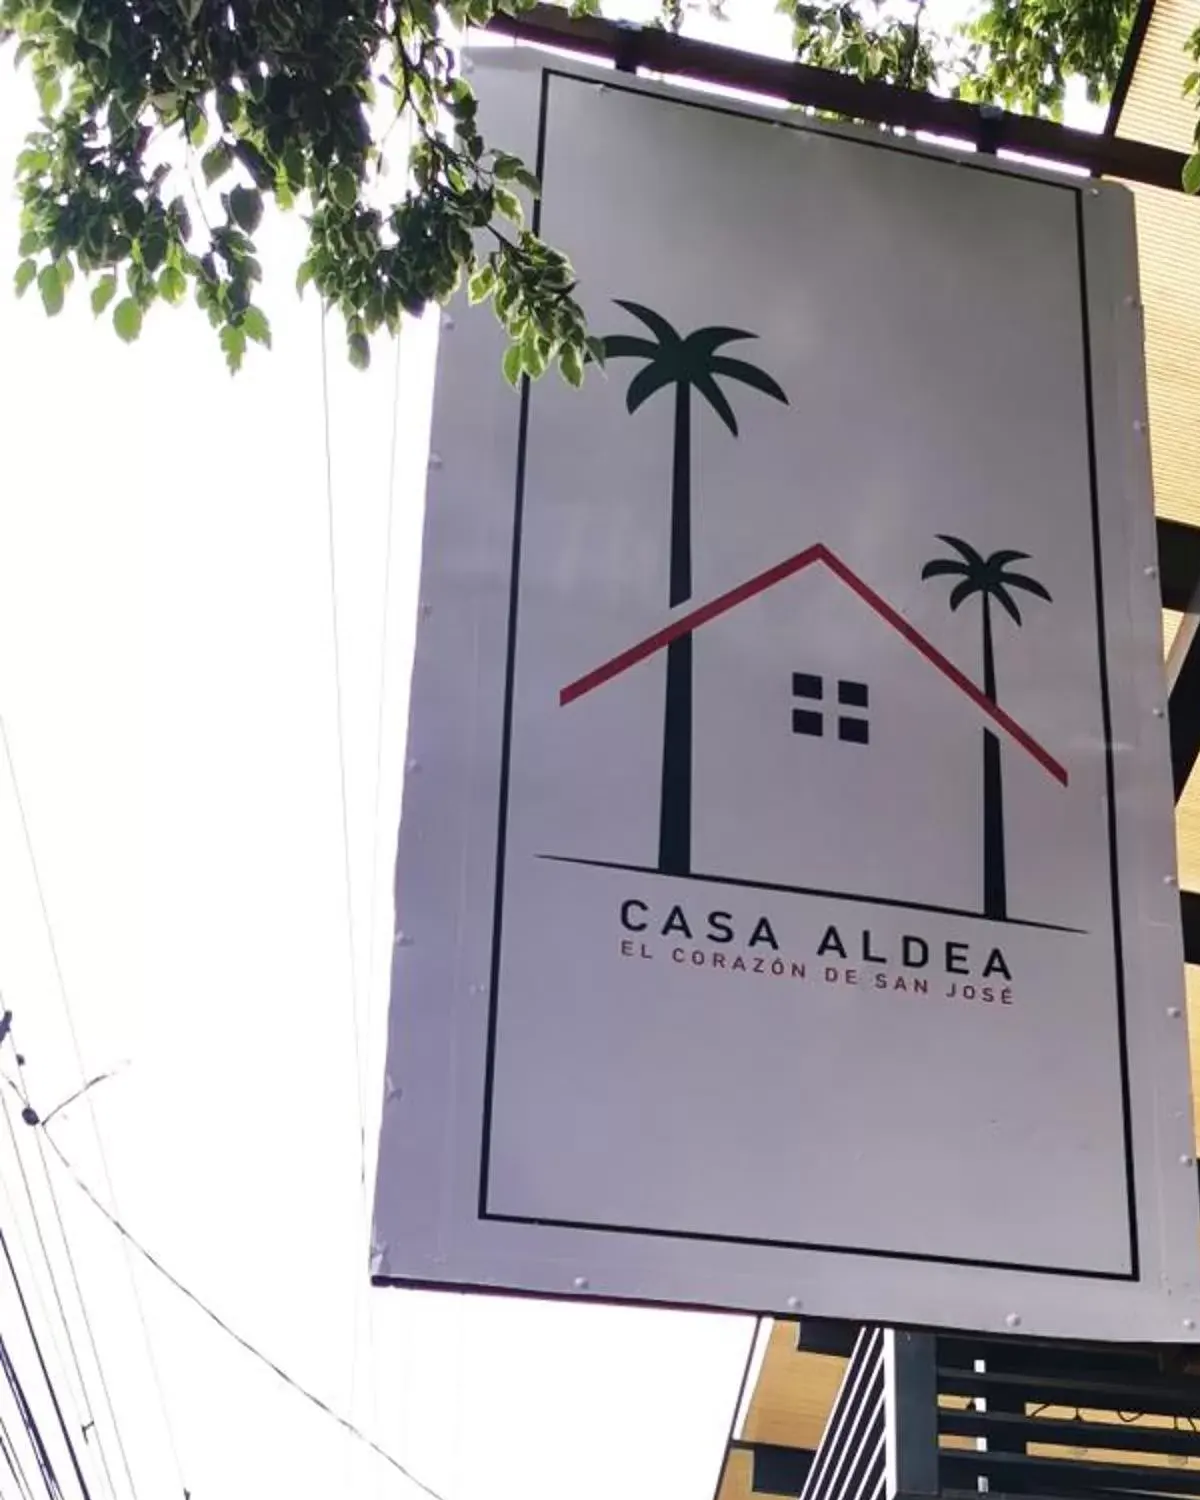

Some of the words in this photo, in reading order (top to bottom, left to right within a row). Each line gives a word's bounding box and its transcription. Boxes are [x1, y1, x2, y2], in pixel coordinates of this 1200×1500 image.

[620, 899, 780, 951] CASA
[816, 925, 1013, 982] ALDEA
[620, 939, 653, 960] EL
[671, 946, 807, 979] CORAZÓN
[824, 966, 858, 986] DE
[874, 972, 929, 995] SAN
[945, 982, 1014, 1006] JOSÉ
